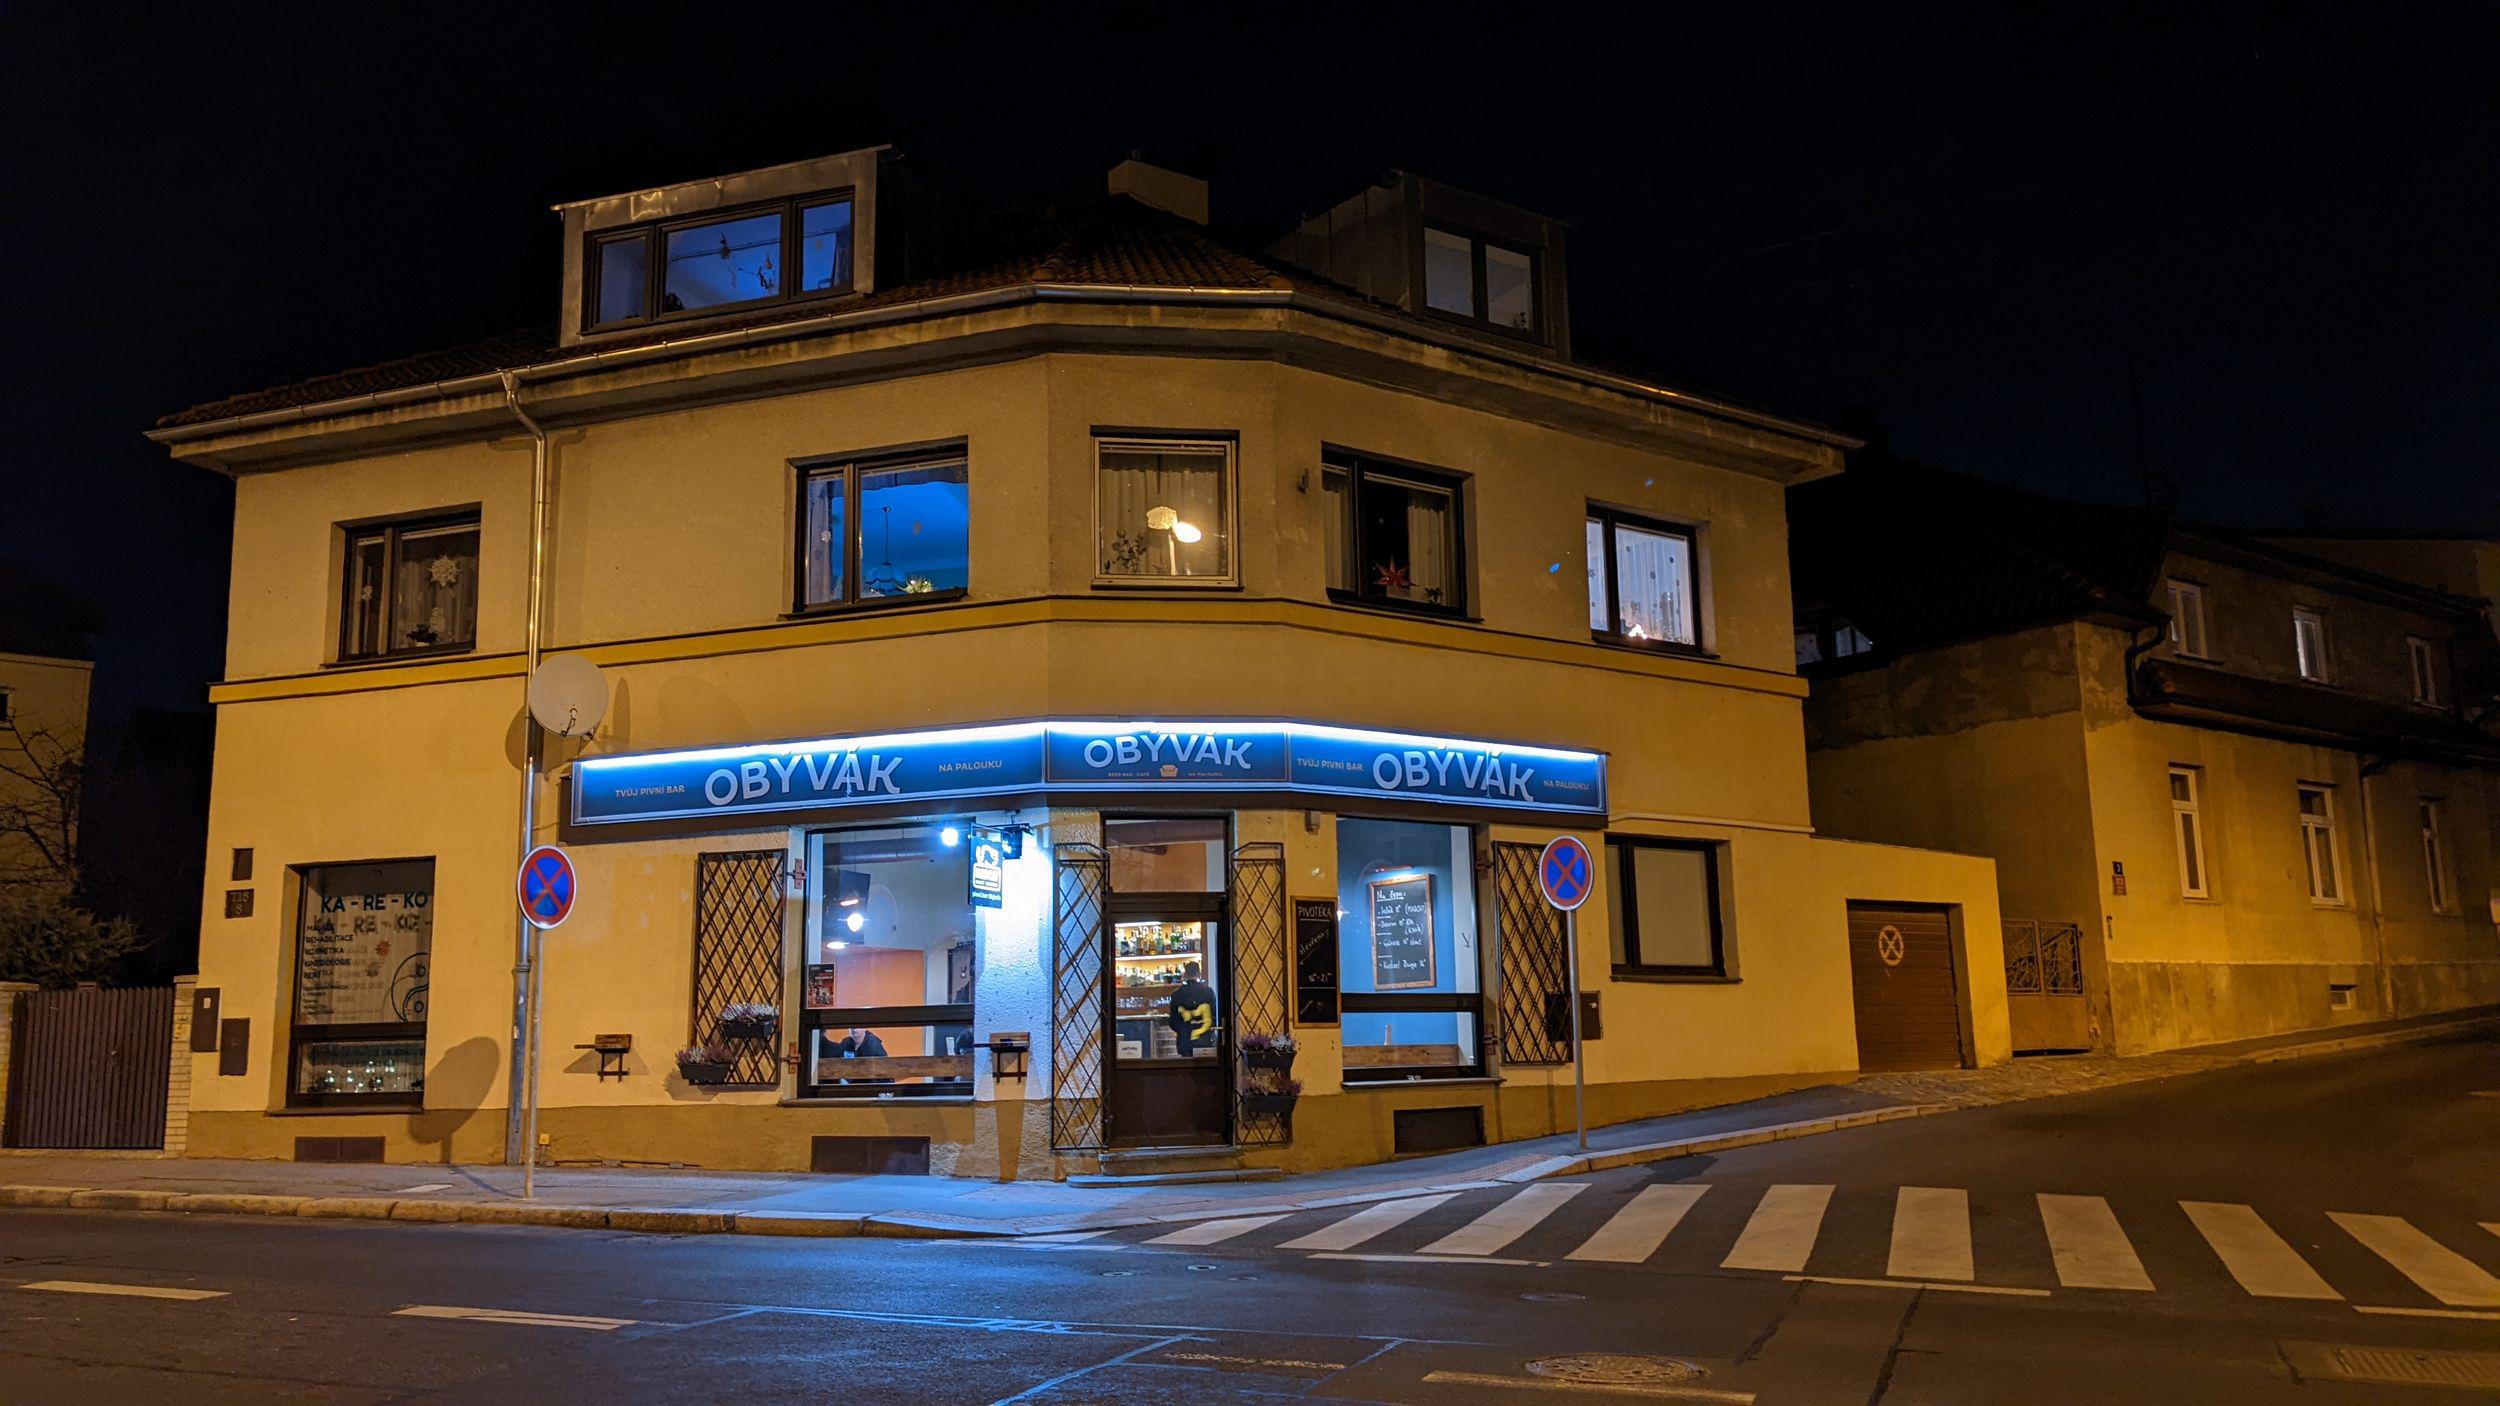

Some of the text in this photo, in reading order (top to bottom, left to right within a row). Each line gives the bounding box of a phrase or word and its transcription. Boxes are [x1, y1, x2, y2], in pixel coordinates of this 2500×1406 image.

[938, 760, 1003, 773] NA PALOUKU
[1346, 761, 1364, 771] BAR
[640, 784, 664, 796] PIVNÍ
[666, 784, 686, 794] BAR
[1543, 779, 1589, 791] NA PALOUKU
[321, 895, 346, 913] KA
[363, 893, 386, 911] RE
[403, 891, 429, 909] KO
[305, 934, 353, 944] REHABILITACE
[305, 947, 344, 956] KOSMETIKA
